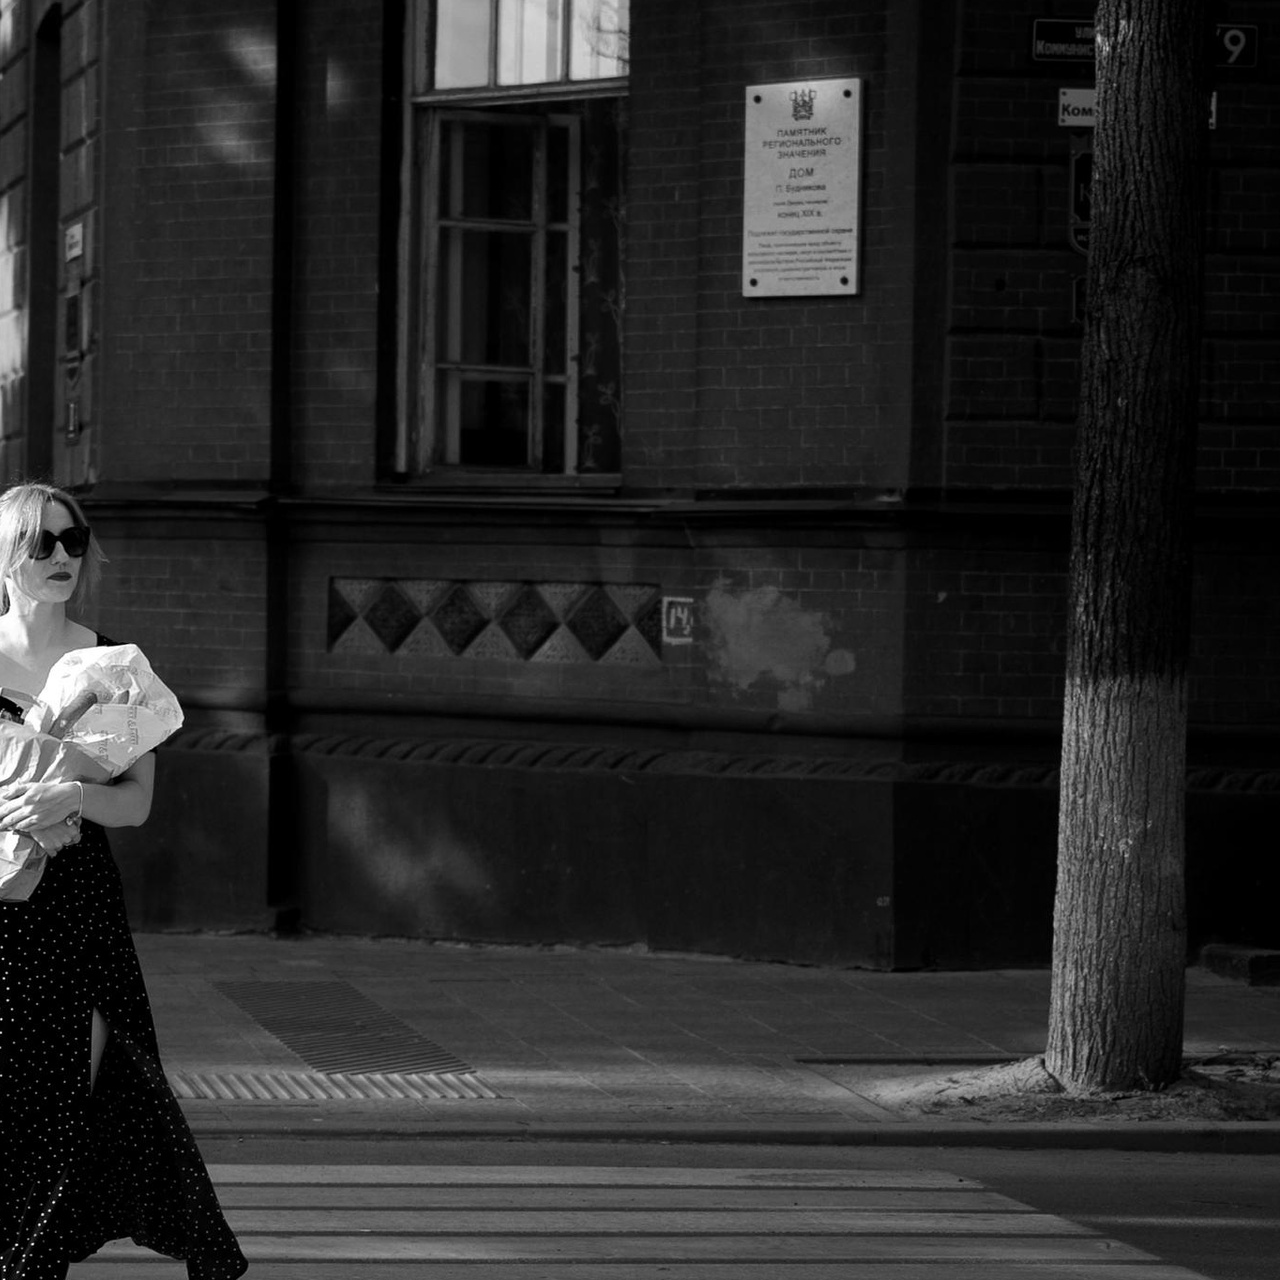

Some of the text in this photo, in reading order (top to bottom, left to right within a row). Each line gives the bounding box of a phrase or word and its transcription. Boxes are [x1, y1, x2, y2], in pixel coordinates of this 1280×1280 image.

[1036, 40, 1094, 56] Коммунис
[1216, 27, 1246, 64] 9
[1062, 103, 1093, 117] Ком
[777, 127, 826, 137] ПАМЯТНИК
[762, 137, 841, 149] РЕГИОНАЛЬНОГО
[777, 149, 826, 159] ЗНАЧЕНИЯ
[789, 167, 814, 179] ДОМ
